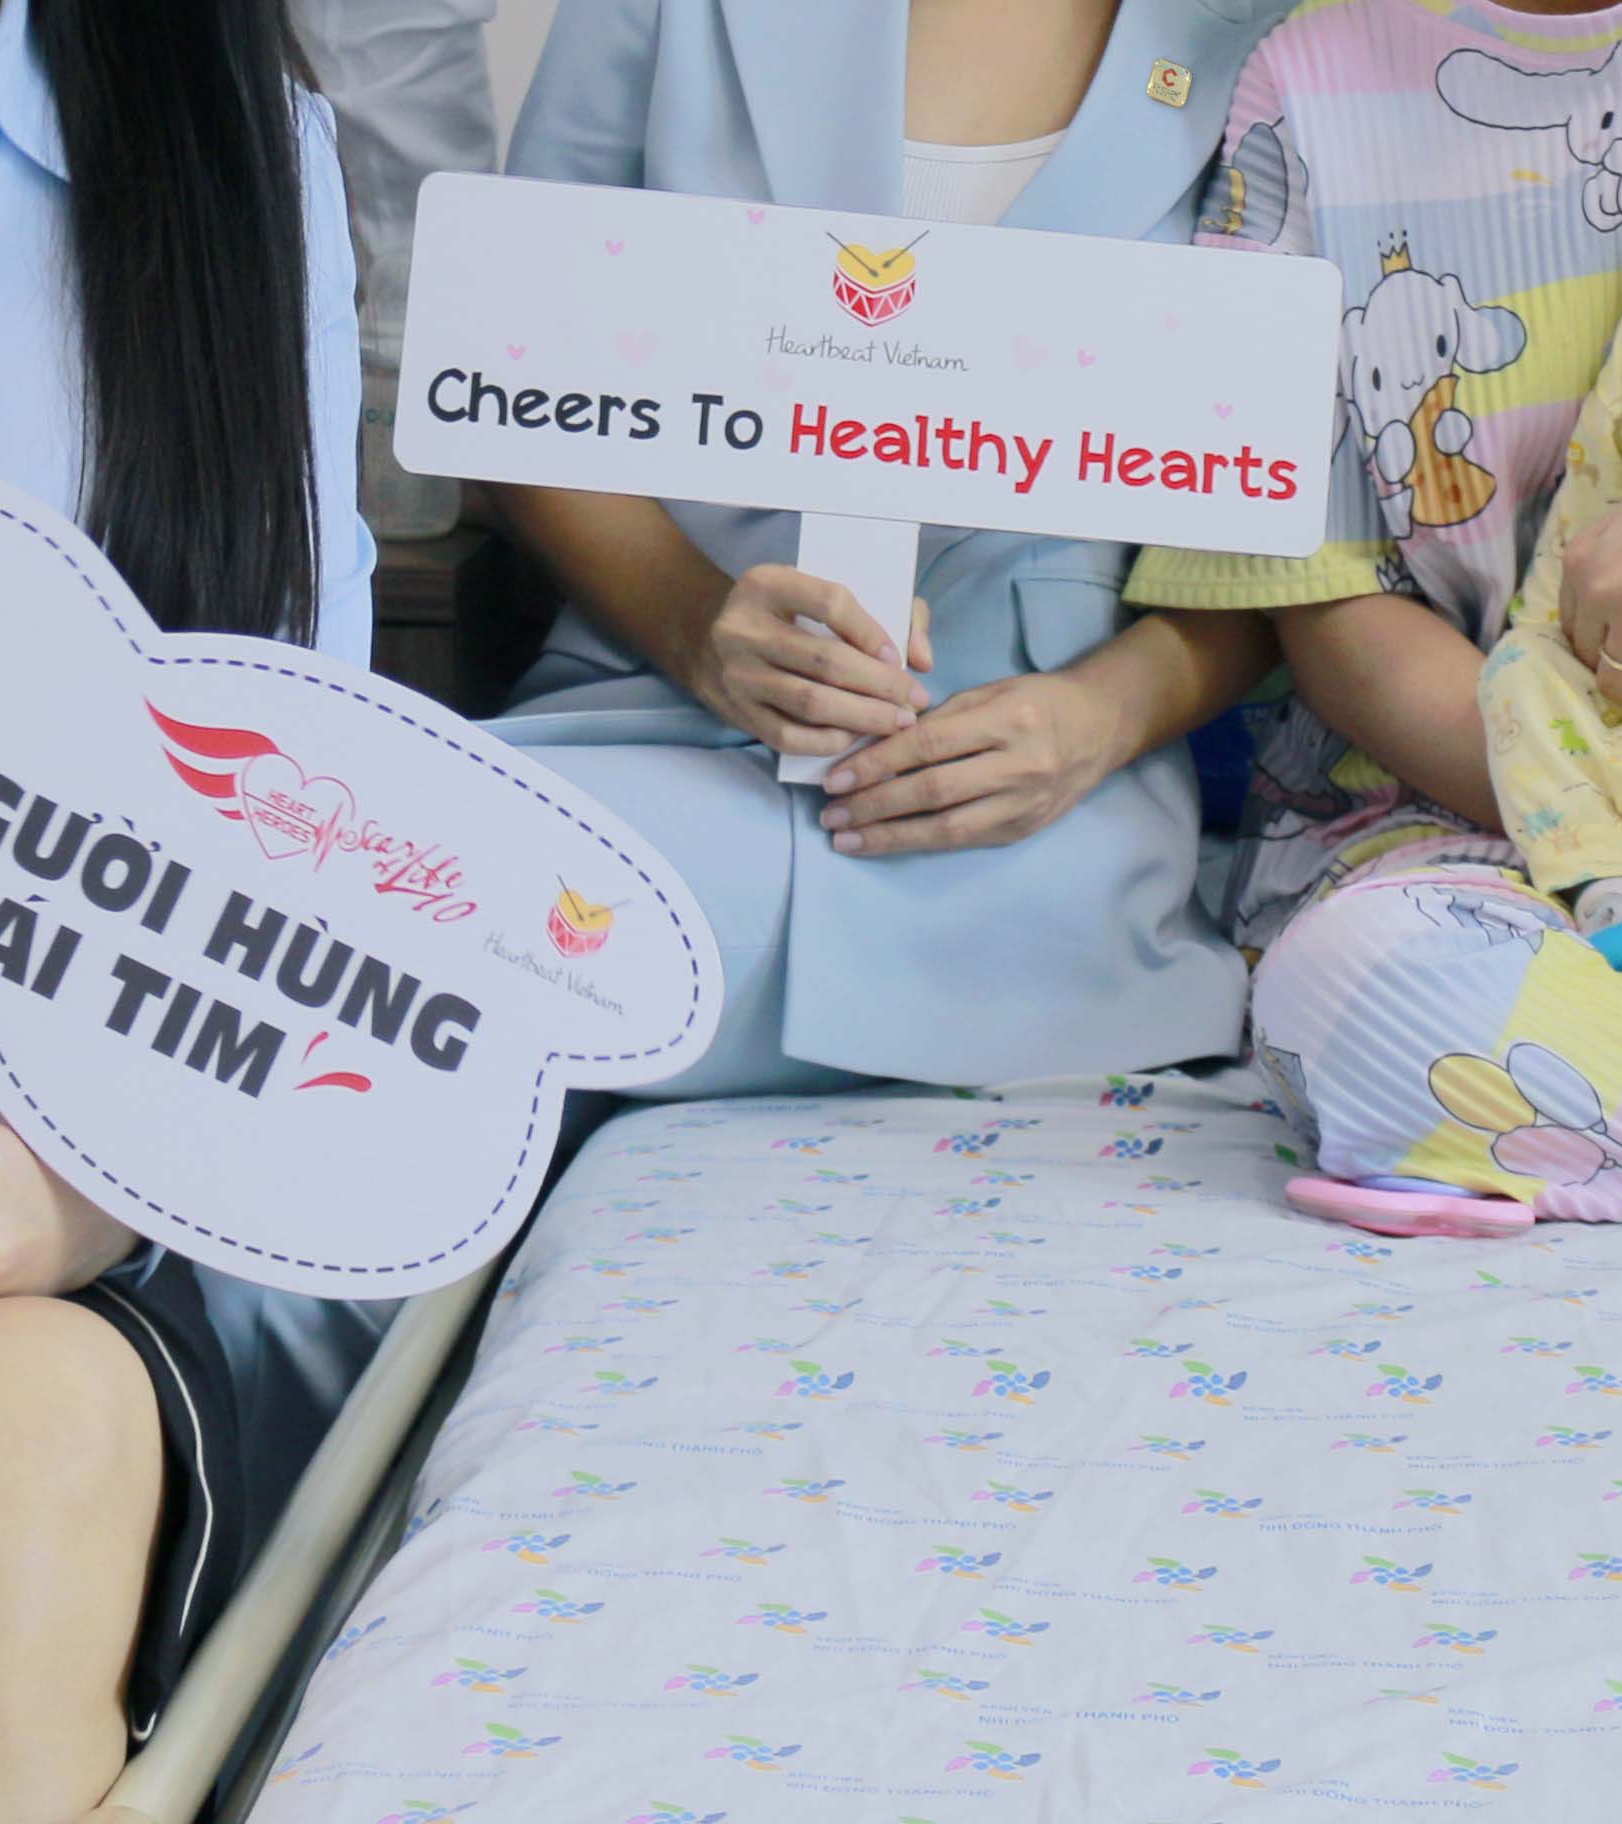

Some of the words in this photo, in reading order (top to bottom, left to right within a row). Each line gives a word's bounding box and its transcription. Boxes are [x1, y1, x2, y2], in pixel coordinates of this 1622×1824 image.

[765, 324, 876, 364] Heartbeat
[882, 341, 971, 373] Vietnam
[426, 365, 662, 442] Cheers
[690, 392, 764, 451] To
[789, 401, 1054, 496] Healthy
[1076, 431, 1301, 502] Hearts
[103, 953, 290, 1100] TIM
[201, 890, 484, 1073] HÙNG
